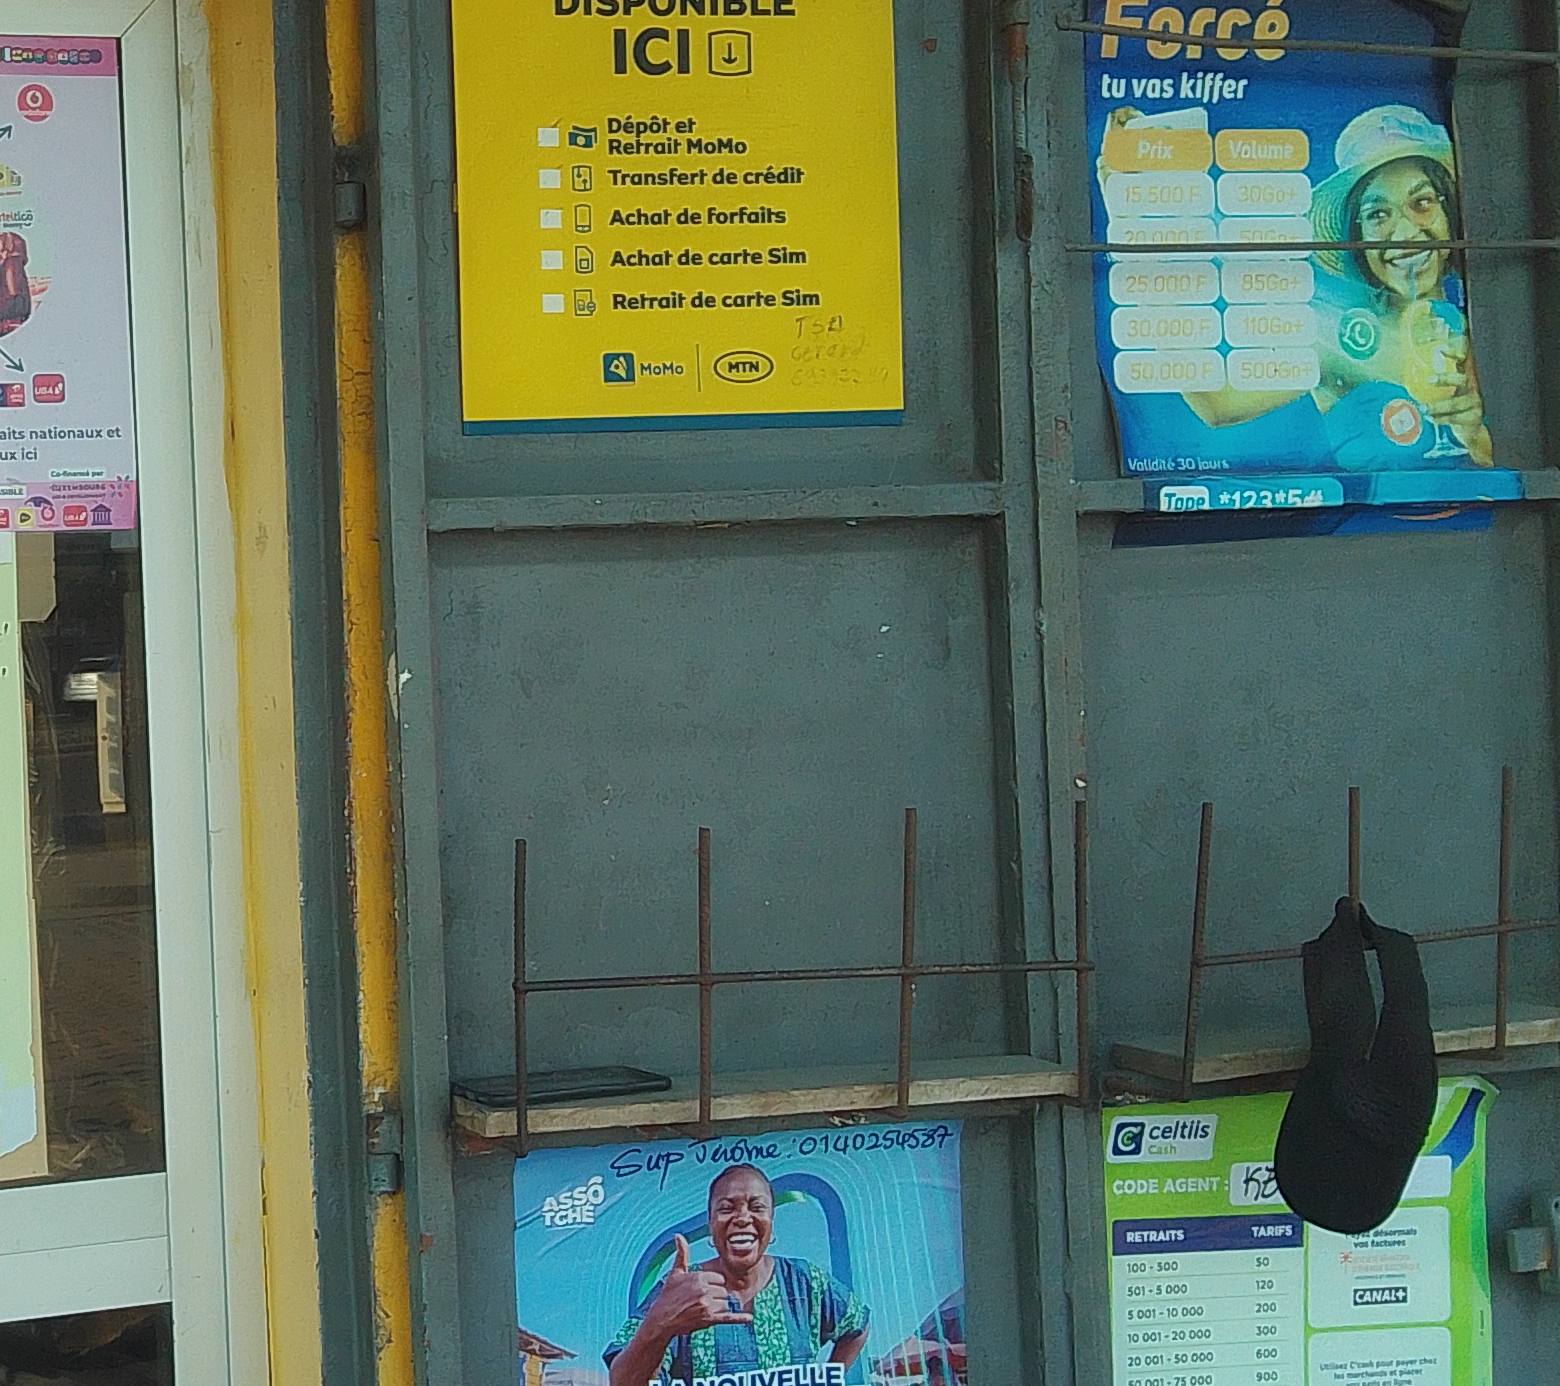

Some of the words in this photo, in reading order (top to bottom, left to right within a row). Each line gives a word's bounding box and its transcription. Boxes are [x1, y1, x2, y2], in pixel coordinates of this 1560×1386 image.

[612, 27, 691, 75] ICI
[1101, 74, 1126, 100] tu
[1130, 77, 1174, 100] vas
[1179, 71, 1248, 105] kiffer
[607, 115, 670, 137] Dépôt
[675, 118, 696, 134] et
[608, 138, 682, 155] Retrait
[686, 138, 747, 155] MoMo
[1138, 141, 1173, 159] Prix
[1229, 140, 1293, 160] Volume
[608, 169, 708, 186] Transfert
[713, 169, 738, 185] de
[742, 166, 804, 183] crédit
[609, 209, 672, 226] Achat
[676, 210, 700, 224] de
[707, 207, 786, 225] forfaits
[610, 250, 673, 267] Achat
[677, 250, 703, 265] de
[708, 249, 764, 265] carte
[768, 249, 807, 264] Sim
[612, 292, 686, 309] Retrait
[691, 292, 716, 308] de
[721, 291, 777, 307] carte
[782, 290, 820, 306] Sim
[640, 362, 684, 376] MoMo
[727, 360, 759, 374] MTN
[29, 427, 103, 440] nationaux
[107, 427, 122, 438] et
[21, 447, 38, 461] ici
[1177, 460, 1195, 471] 30
[1147, 1120, 1210, 1141] celtiis
[1147, 1144, 1177, 1155] Cash
[1113, 1178, 1159, 1194] CODE
[1163, 1177, 1221, 1193] AGENT
[1126, 1230, 1185, 1243] RETRAITS
[1251, 1225, 1292, 1238] TARIFS
[1127, 1264, 1146, 1273] 100
[1157, 1261, 1178, 1272] 500
[1256, 1257, 1269, 1267] 50
[1256, 1280, 1274, 1290] 120
[1355, 1288, 1406, 1303] CANAL+
[1256, 1302, 1276, 1313] 200
